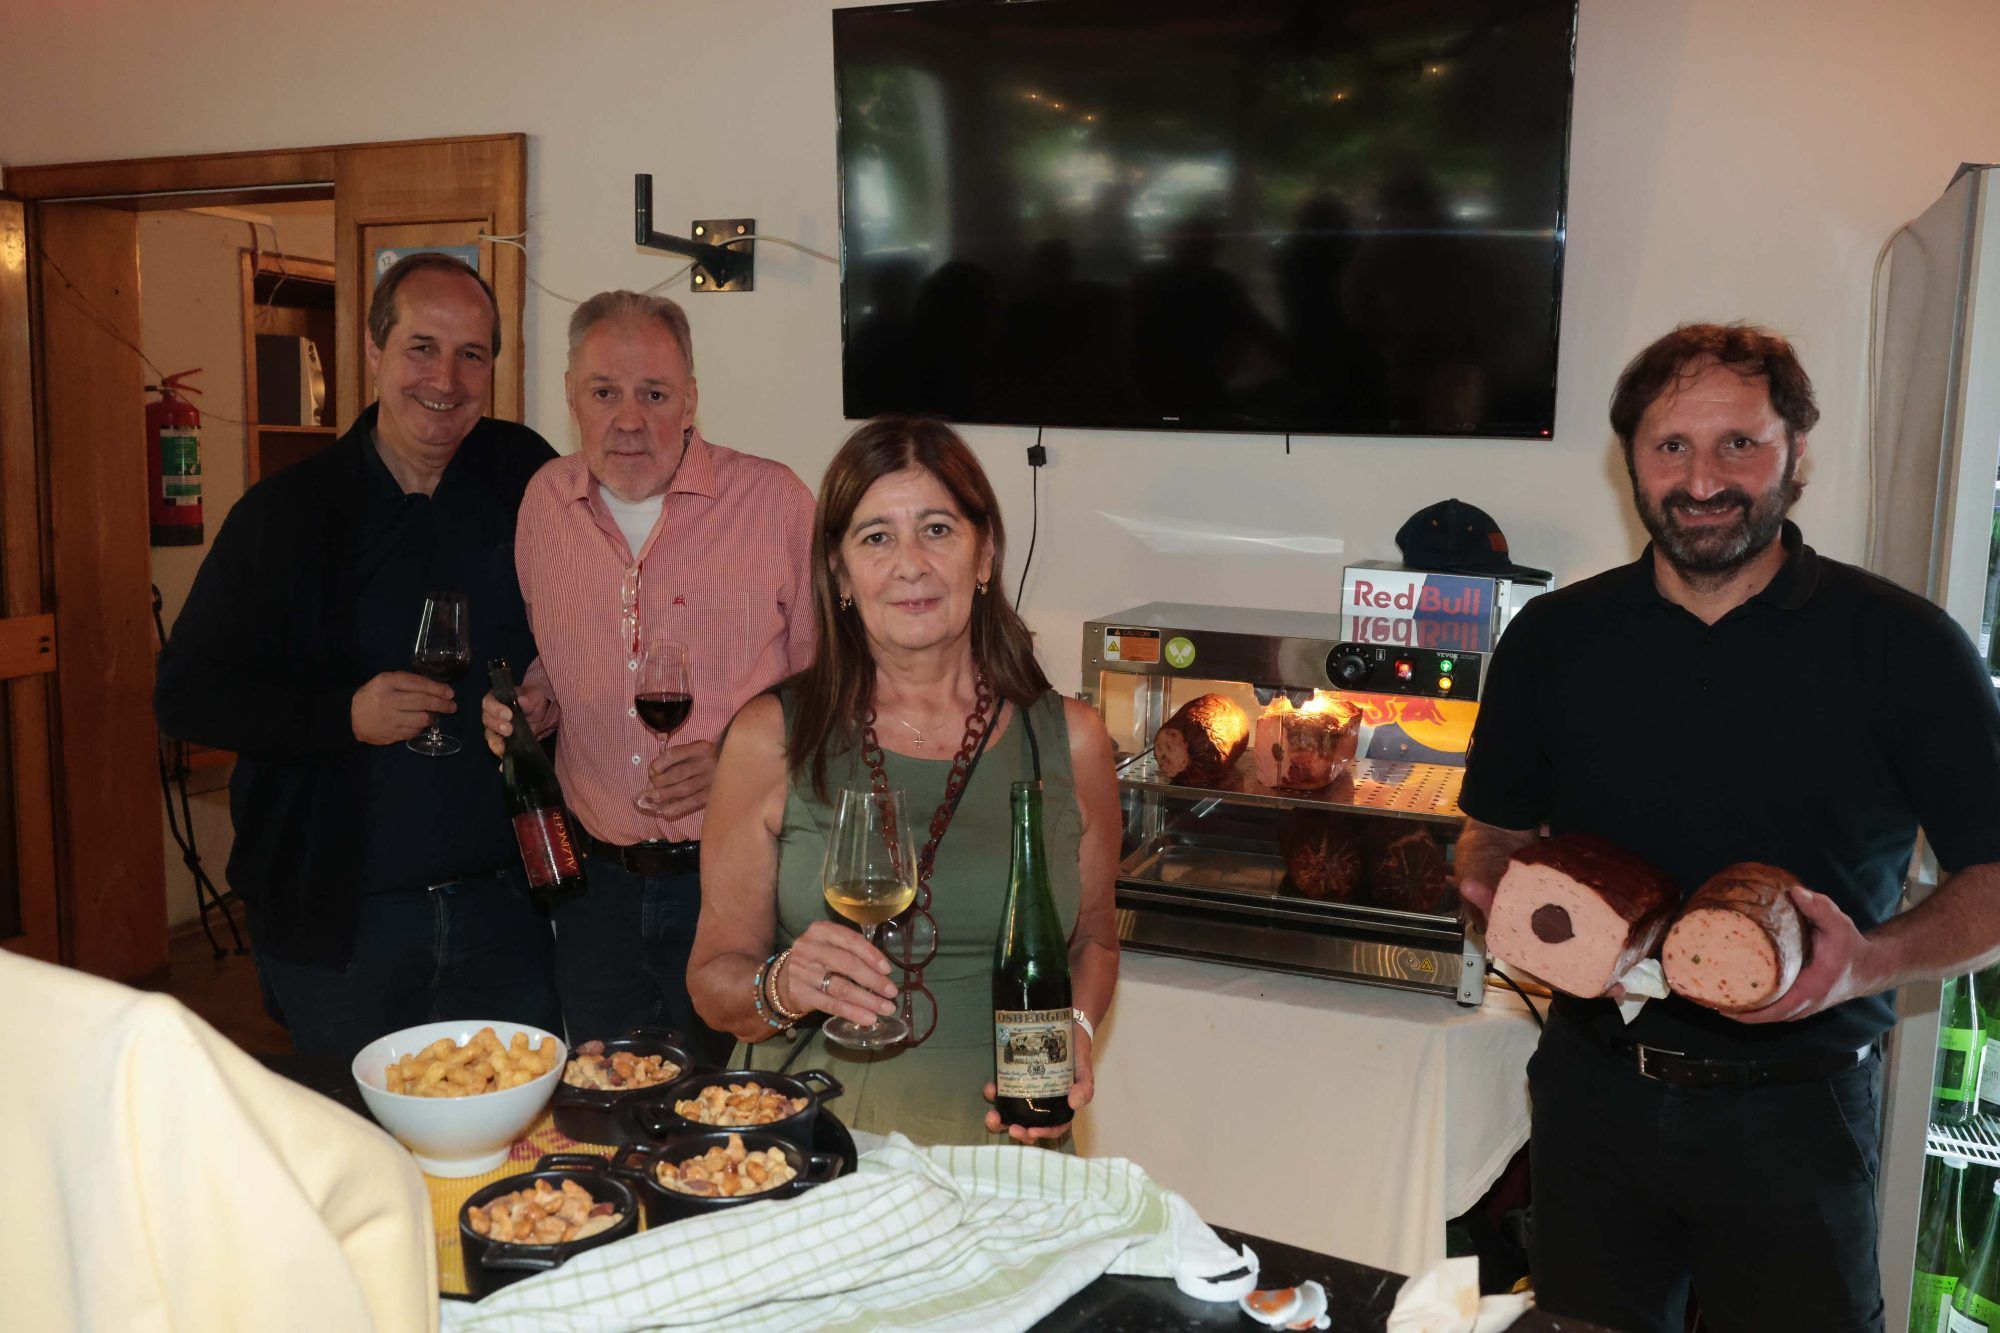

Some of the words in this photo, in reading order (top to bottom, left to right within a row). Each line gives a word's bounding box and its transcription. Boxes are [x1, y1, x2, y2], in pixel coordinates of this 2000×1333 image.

[1353, 580, 1415, 610] Red
[1419, 585, 1481, 616] Bull
[1122, 629, 1151, 637] CAUTION
[552, 811, 577, 870] ALZINGER
